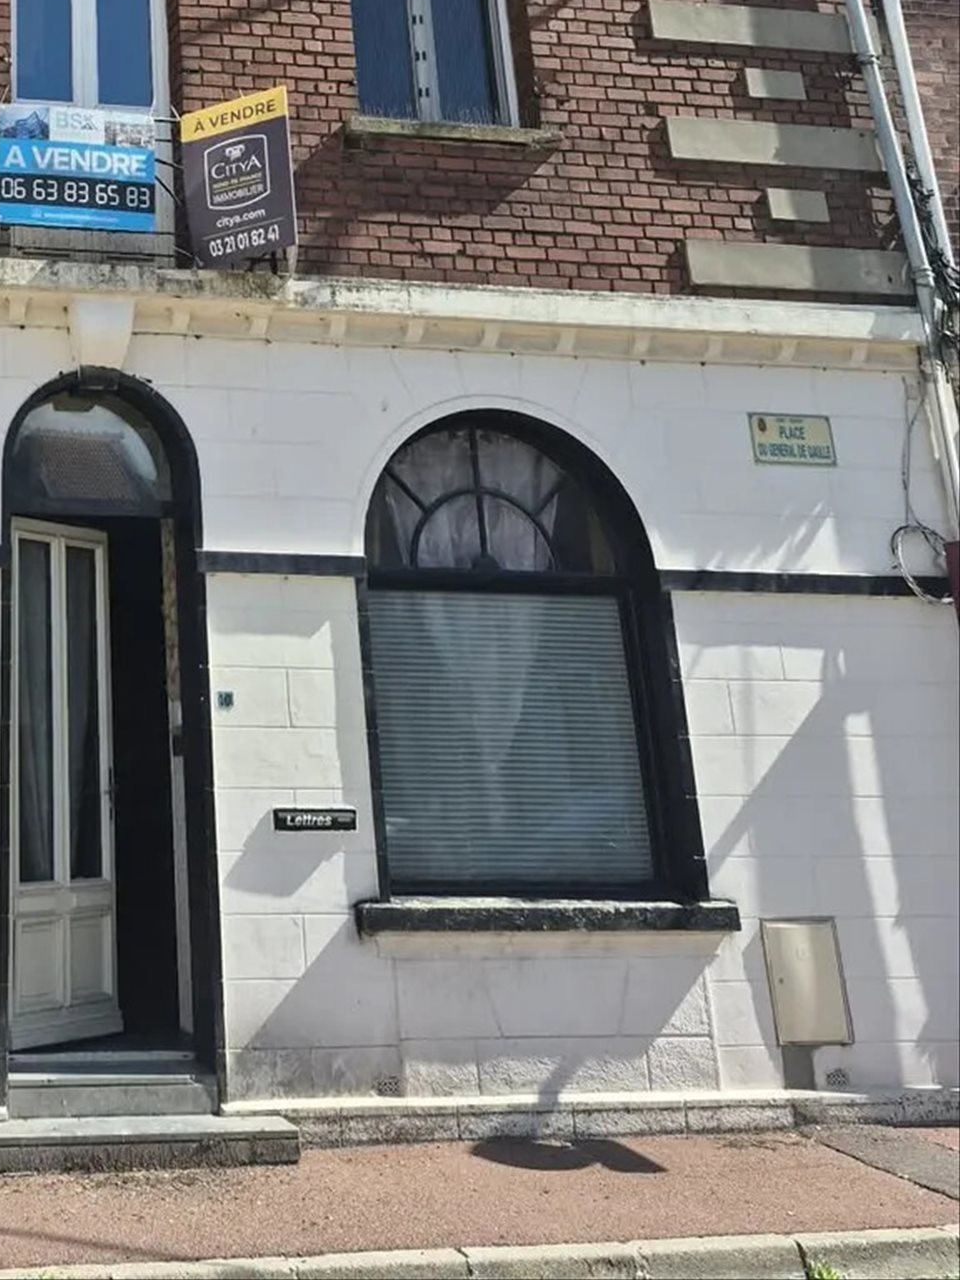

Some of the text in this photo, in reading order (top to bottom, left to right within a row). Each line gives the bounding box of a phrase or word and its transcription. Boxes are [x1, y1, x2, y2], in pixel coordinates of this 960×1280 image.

[209, 99, 276, 128] VENDRE
[4, 145, 147, 177] A VENDRE
[1, 177, 150, 208] 06 63 83 65 83
[216, 208, 266, 228] citya.com
[209, 224, 280, 257] 03 21 01 82 41
[778, 425, 806, 441] PLACE
[286, 814, 333, 827] Lettres
